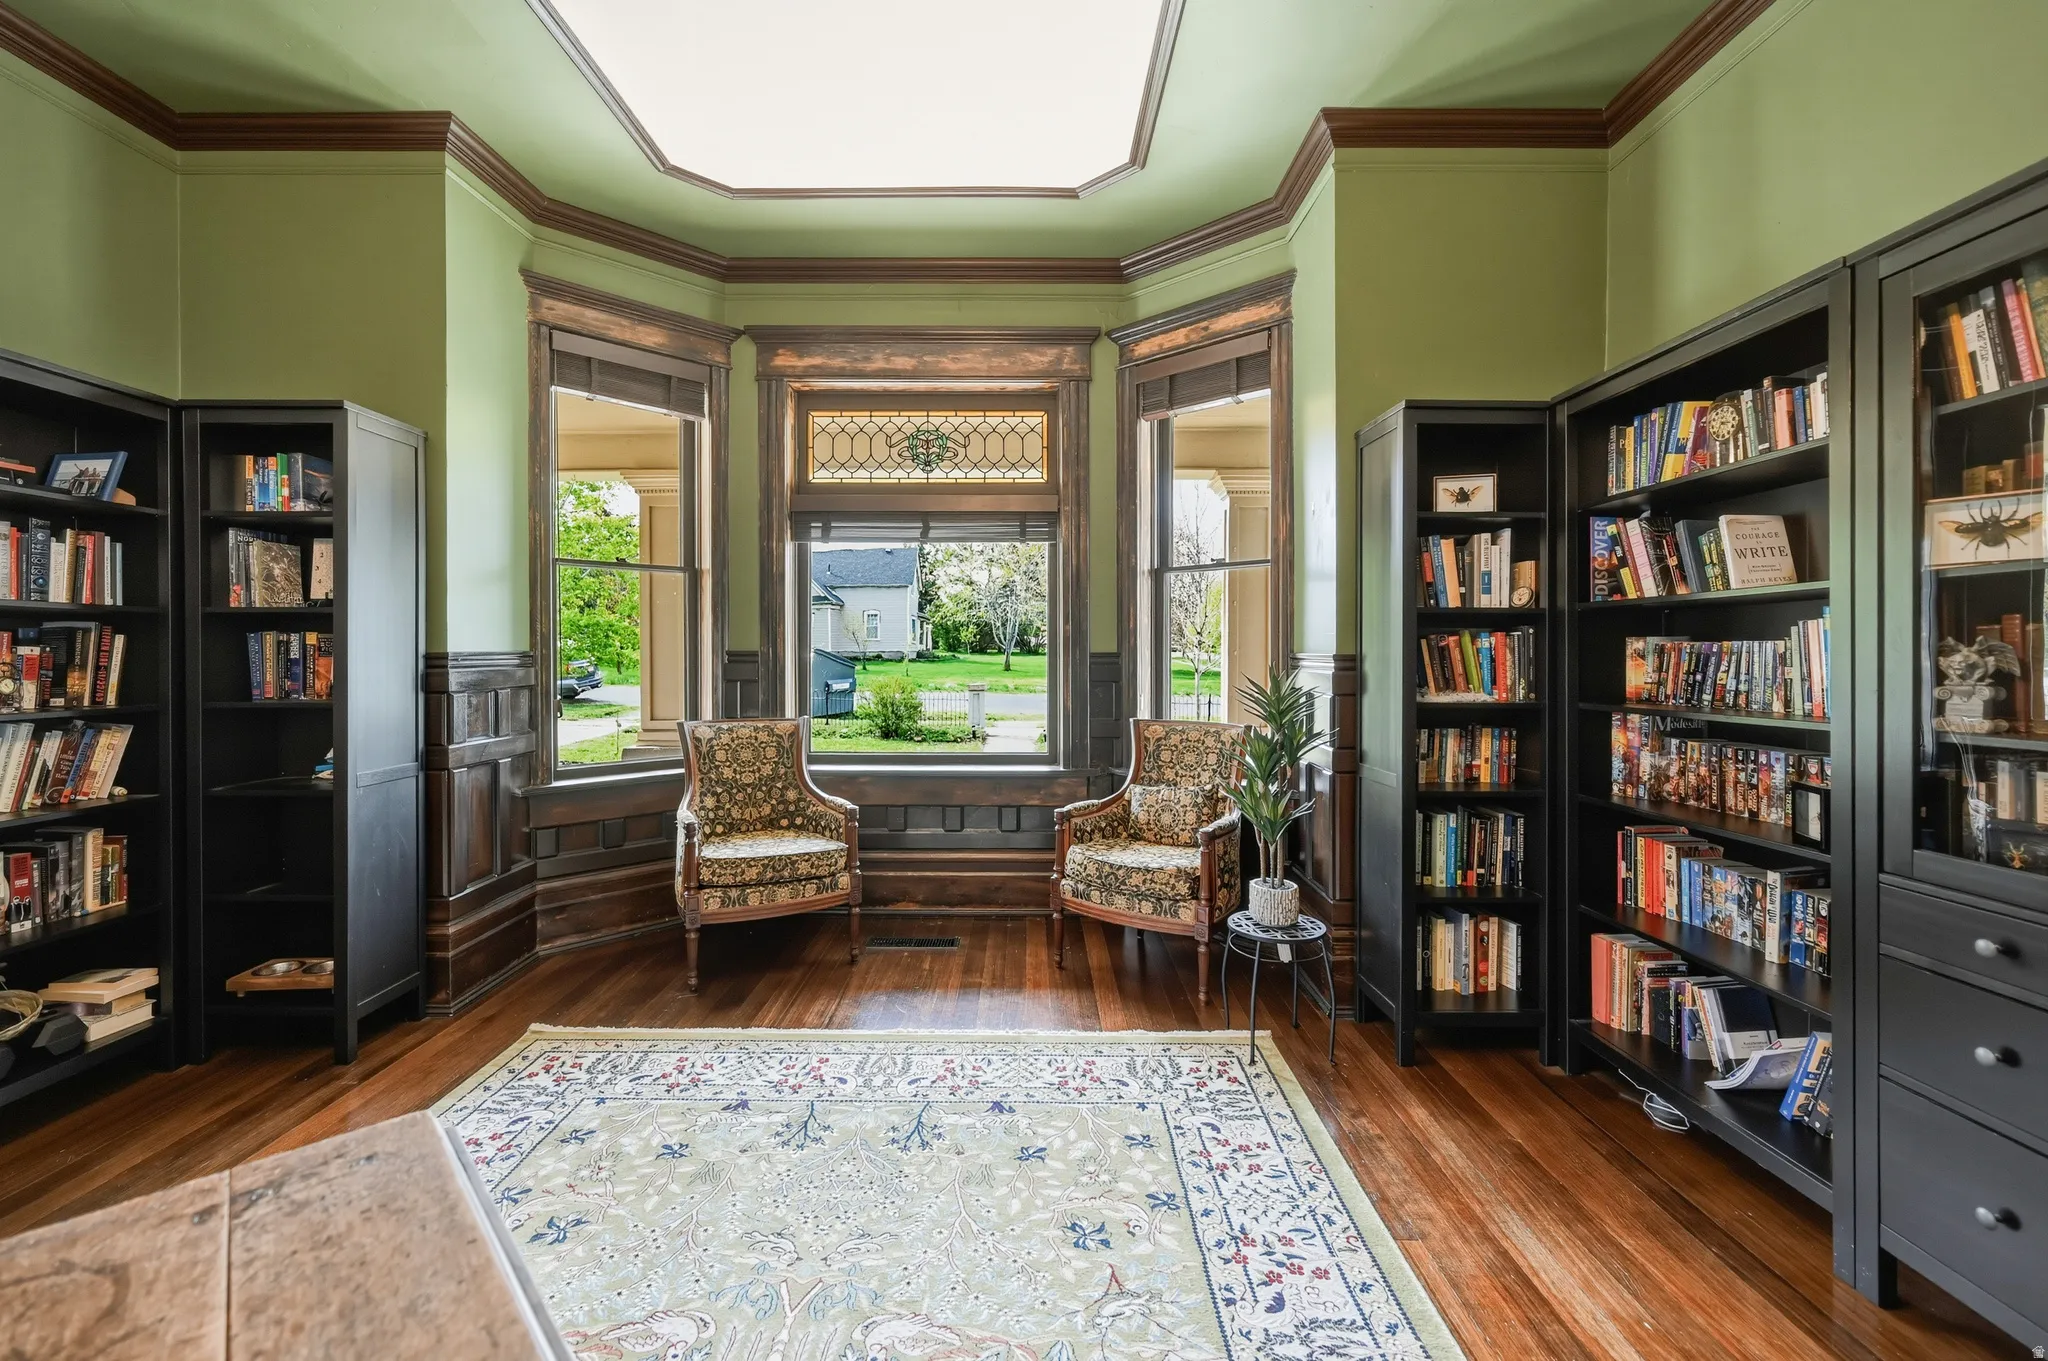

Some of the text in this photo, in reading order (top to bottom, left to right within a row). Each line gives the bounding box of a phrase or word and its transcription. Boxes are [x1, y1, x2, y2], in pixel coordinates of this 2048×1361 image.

[1735, 531, 1780, 540] COURAGE
[1594, 520, 1608, 595] DISCOVER
[1734, 545, 1789, 560] WRITE
[1740, 577, 1765, 585] RALPH
